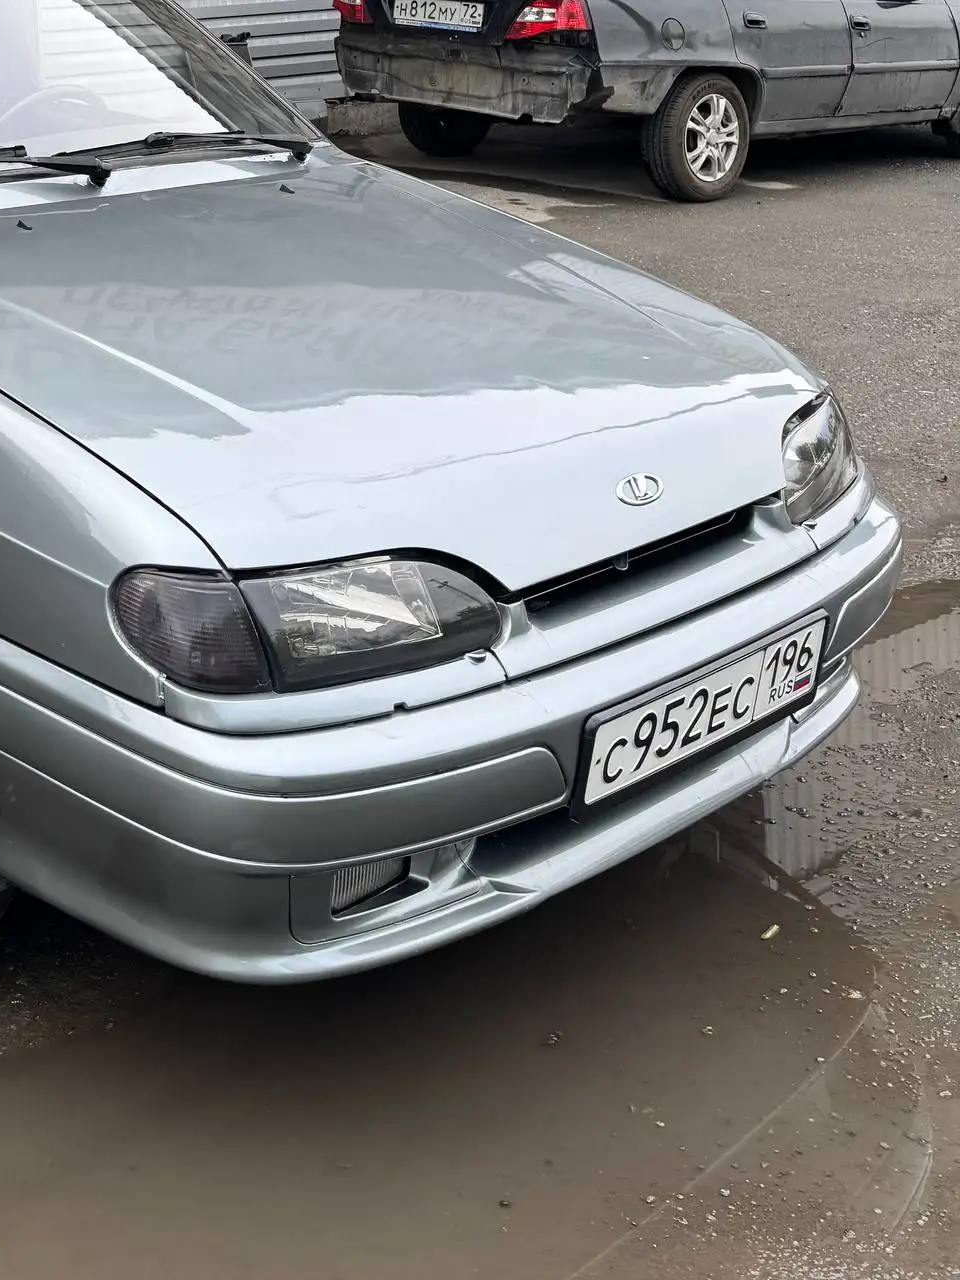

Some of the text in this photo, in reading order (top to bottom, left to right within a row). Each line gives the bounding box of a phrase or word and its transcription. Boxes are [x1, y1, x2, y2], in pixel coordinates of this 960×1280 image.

[400, 0, 478, 22] Н812МУ 72
[768, 682, 793, 704] RUS
[602, 630, 814, 784] С952ЕС 196
